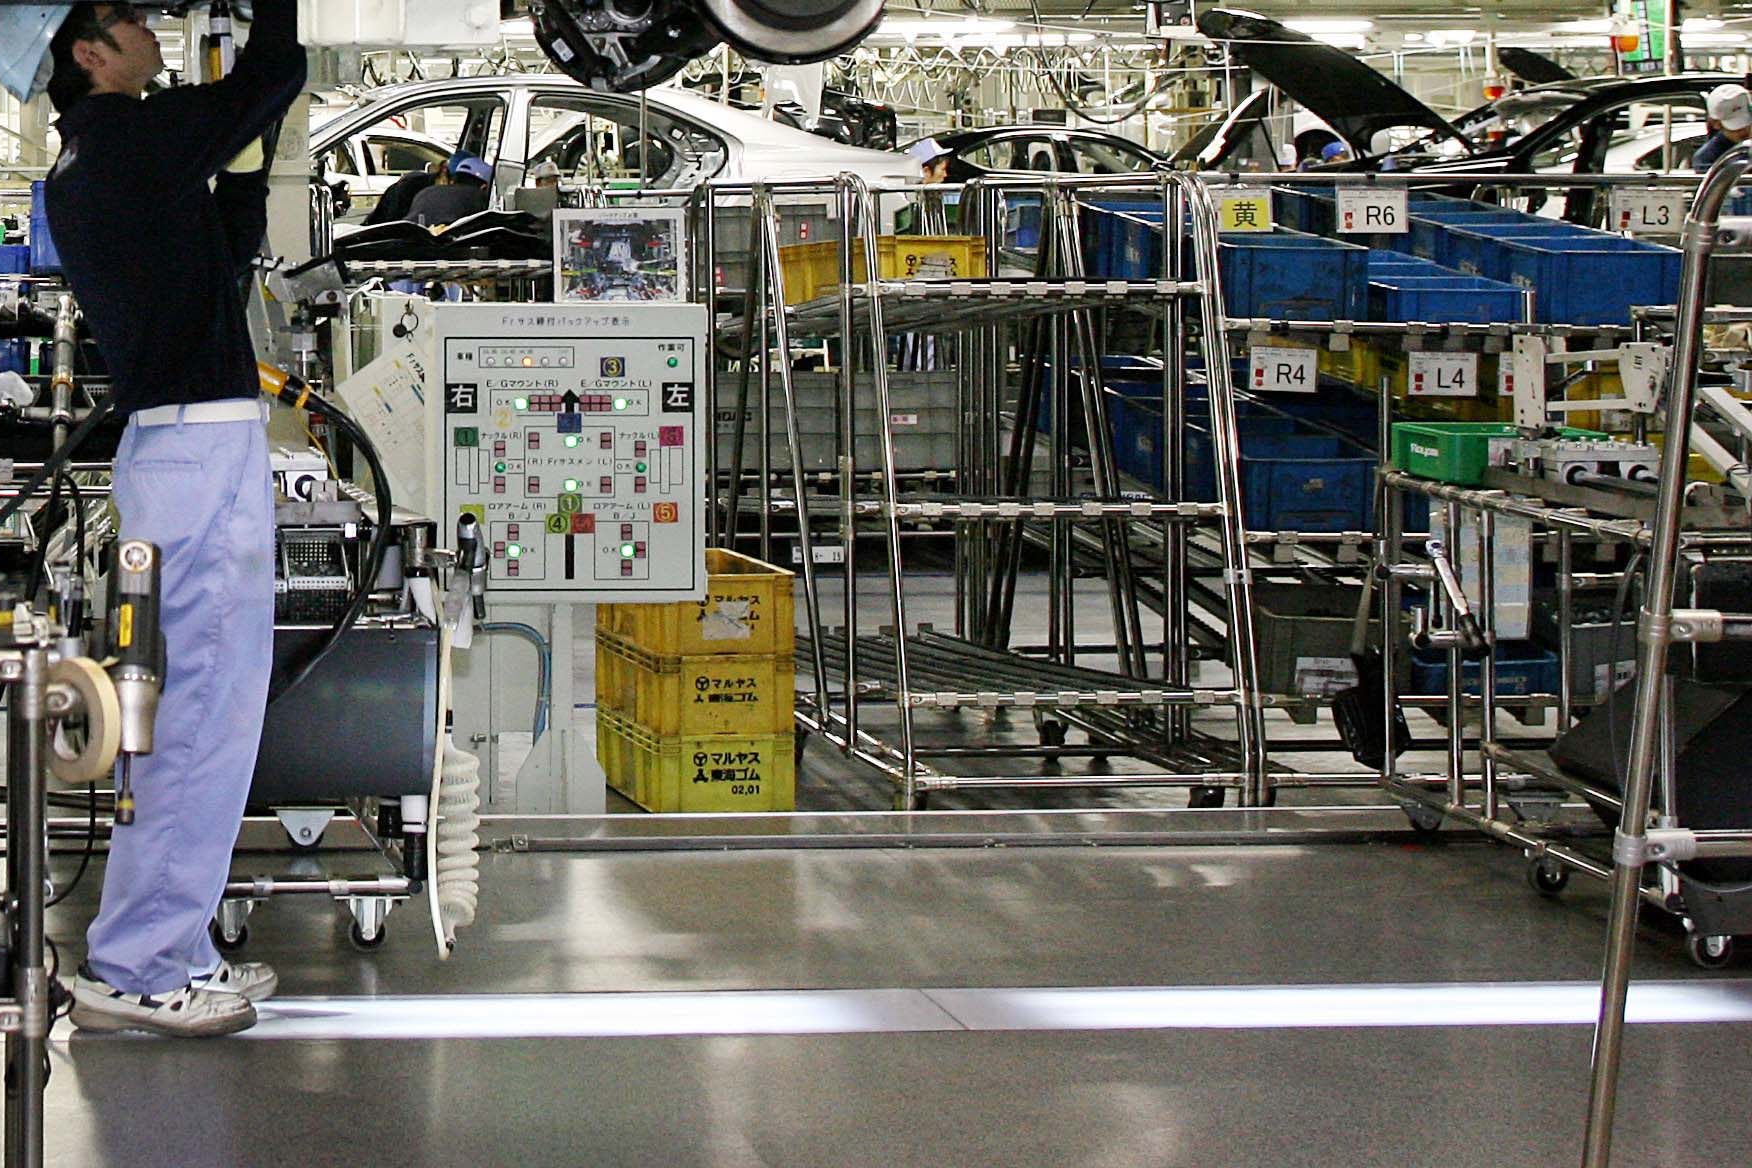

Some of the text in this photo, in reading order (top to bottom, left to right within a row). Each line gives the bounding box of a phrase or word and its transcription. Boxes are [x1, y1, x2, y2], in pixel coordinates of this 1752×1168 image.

[1232, 202, 1257, 227] 黄
[1366, 206, 1395, 225] R6
[1643, 205, 1669, 225] L3
[1276, 363, 1306, 385] R4
[1438, 367, 1465, 388] L4
[450, 385, 475, 408] 右
[666, 384, 690, 407] 左
[711, 678, 757, 689] マルヤス
[710, 751, 761, 765] マルヤス
[710, 767, 761, 782] 東海ゴム
